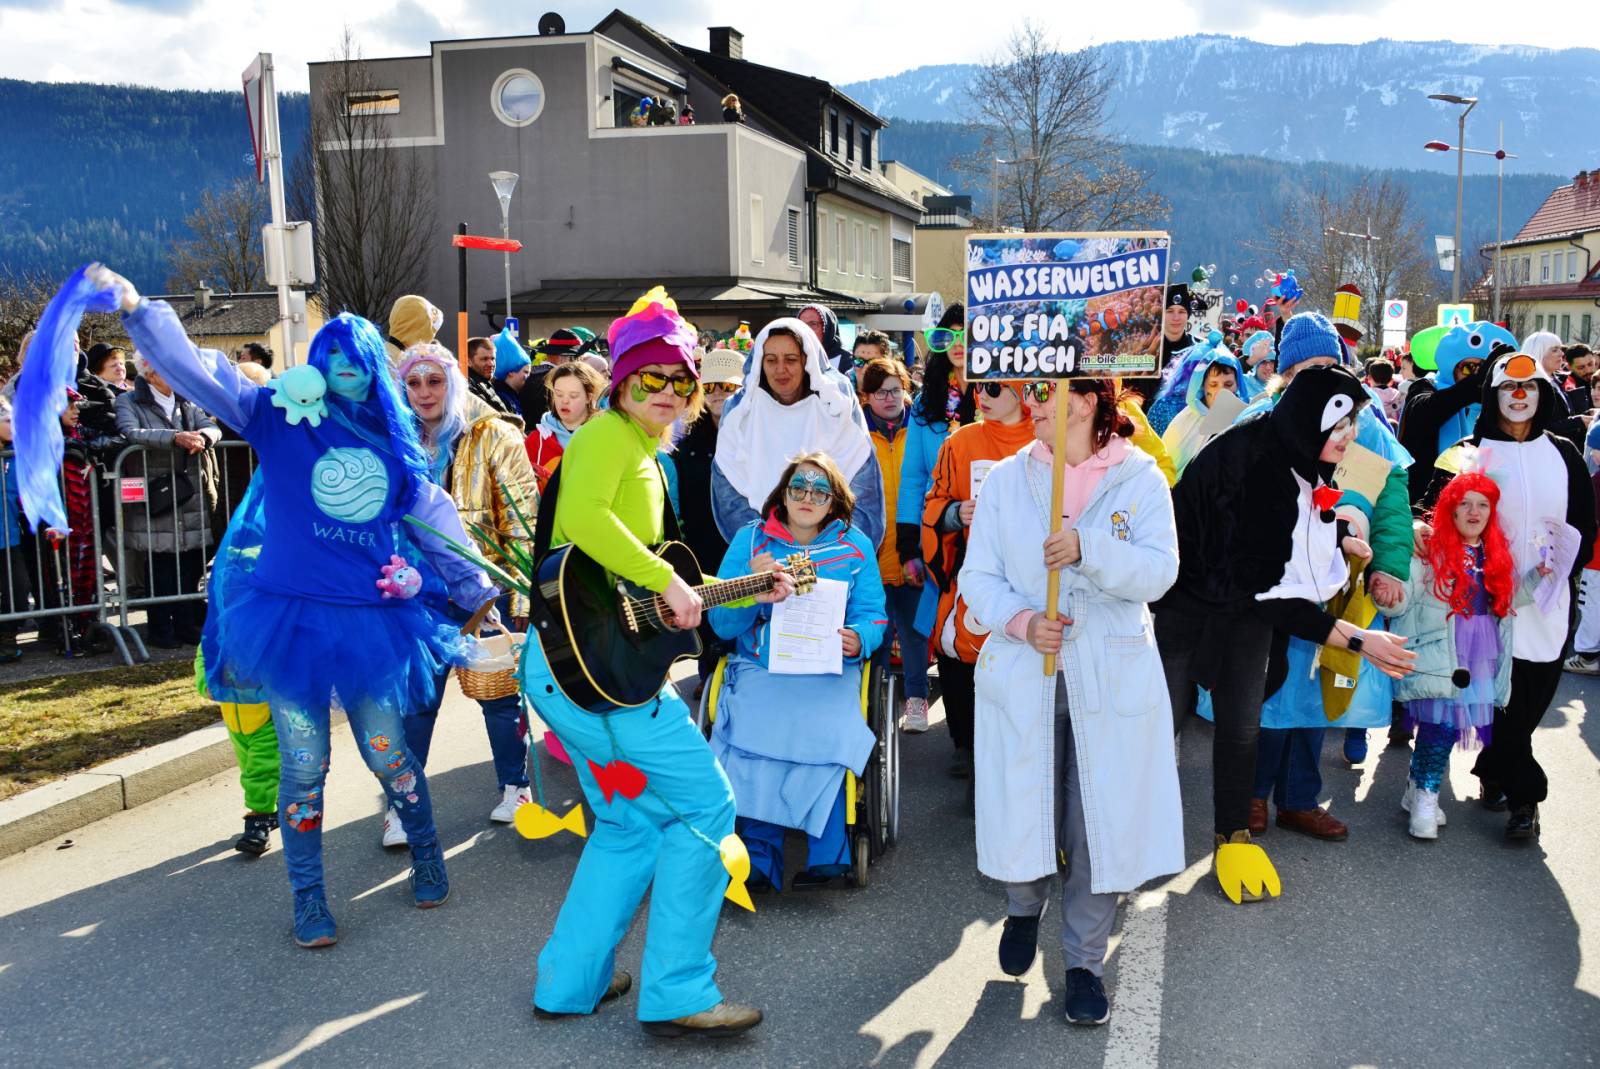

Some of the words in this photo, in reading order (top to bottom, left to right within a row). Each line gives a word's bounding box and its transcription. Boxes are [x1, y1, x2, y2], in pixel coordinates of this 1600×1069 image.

[970, 253, 1159, 302] WASSERWELTEN
[972, 314, 1014, 342] OIS
[1023, 313, 1068, 341] FIA
[313, 522, 376, 547] WATER
